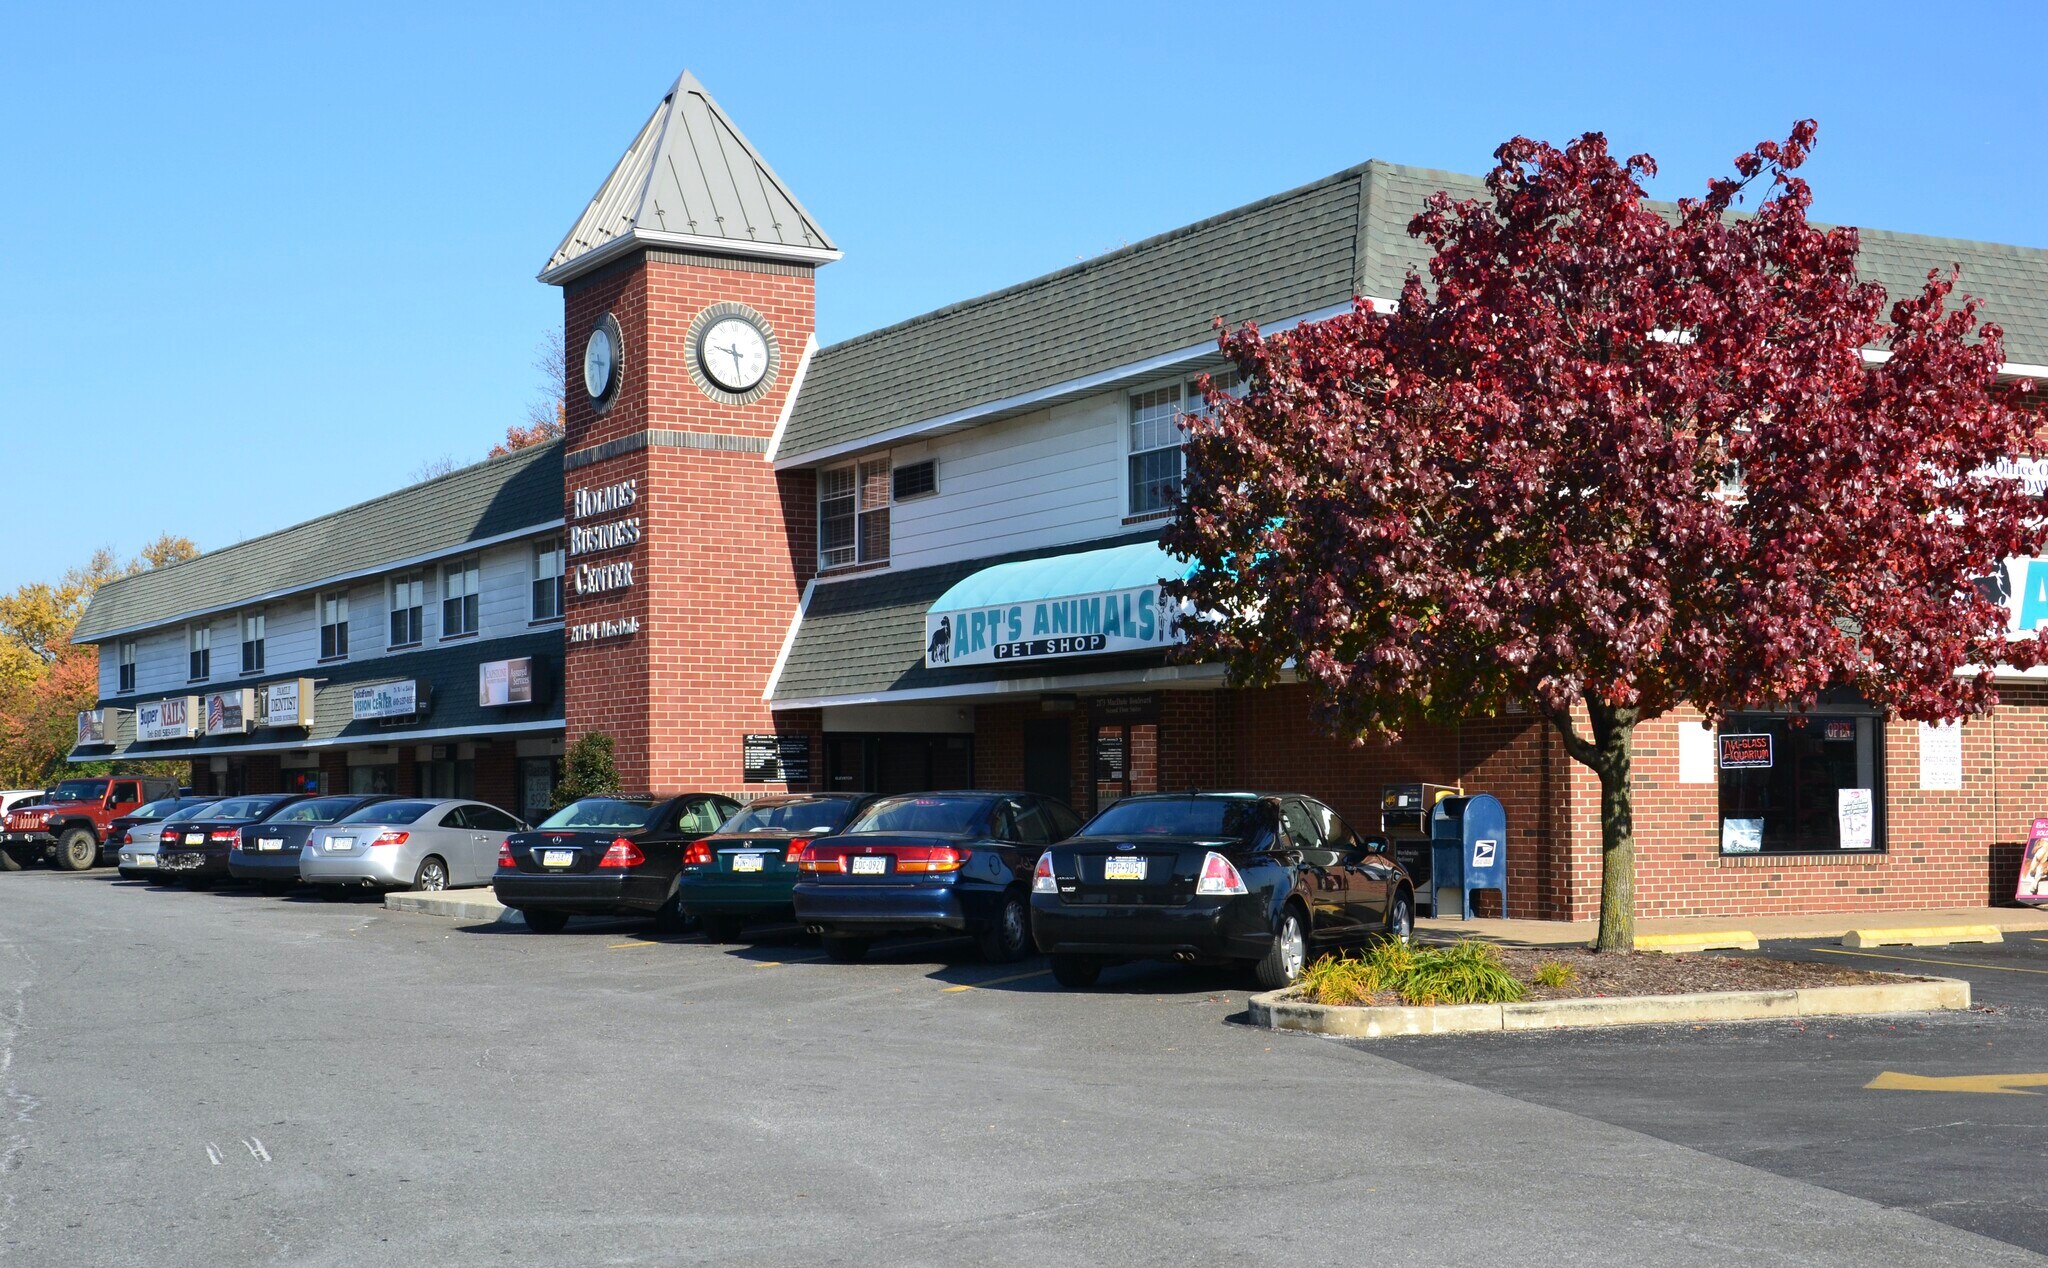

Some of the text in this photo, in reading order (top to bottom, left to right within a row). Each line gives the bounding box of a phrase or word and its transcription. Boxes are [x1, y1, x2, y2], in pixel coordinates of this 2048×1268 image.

[573, 479, 637, 520] HOLMES
[569, 517, 641, 556] BUSINESS
[574, 561, 634, 595] CENTER
[953, 589, 1155, 659] ART'S ANIMALS
[999, 636, 1101, 658] PET SHOP
[139, 700, 186, 728] Super NAILS
[270, 696, 297, 712] DENTIST
[353, 699, 372, 712] VISION
[372, 695, 393, 710] CENTER
[1827, 722, 1851, 738] OPEN
